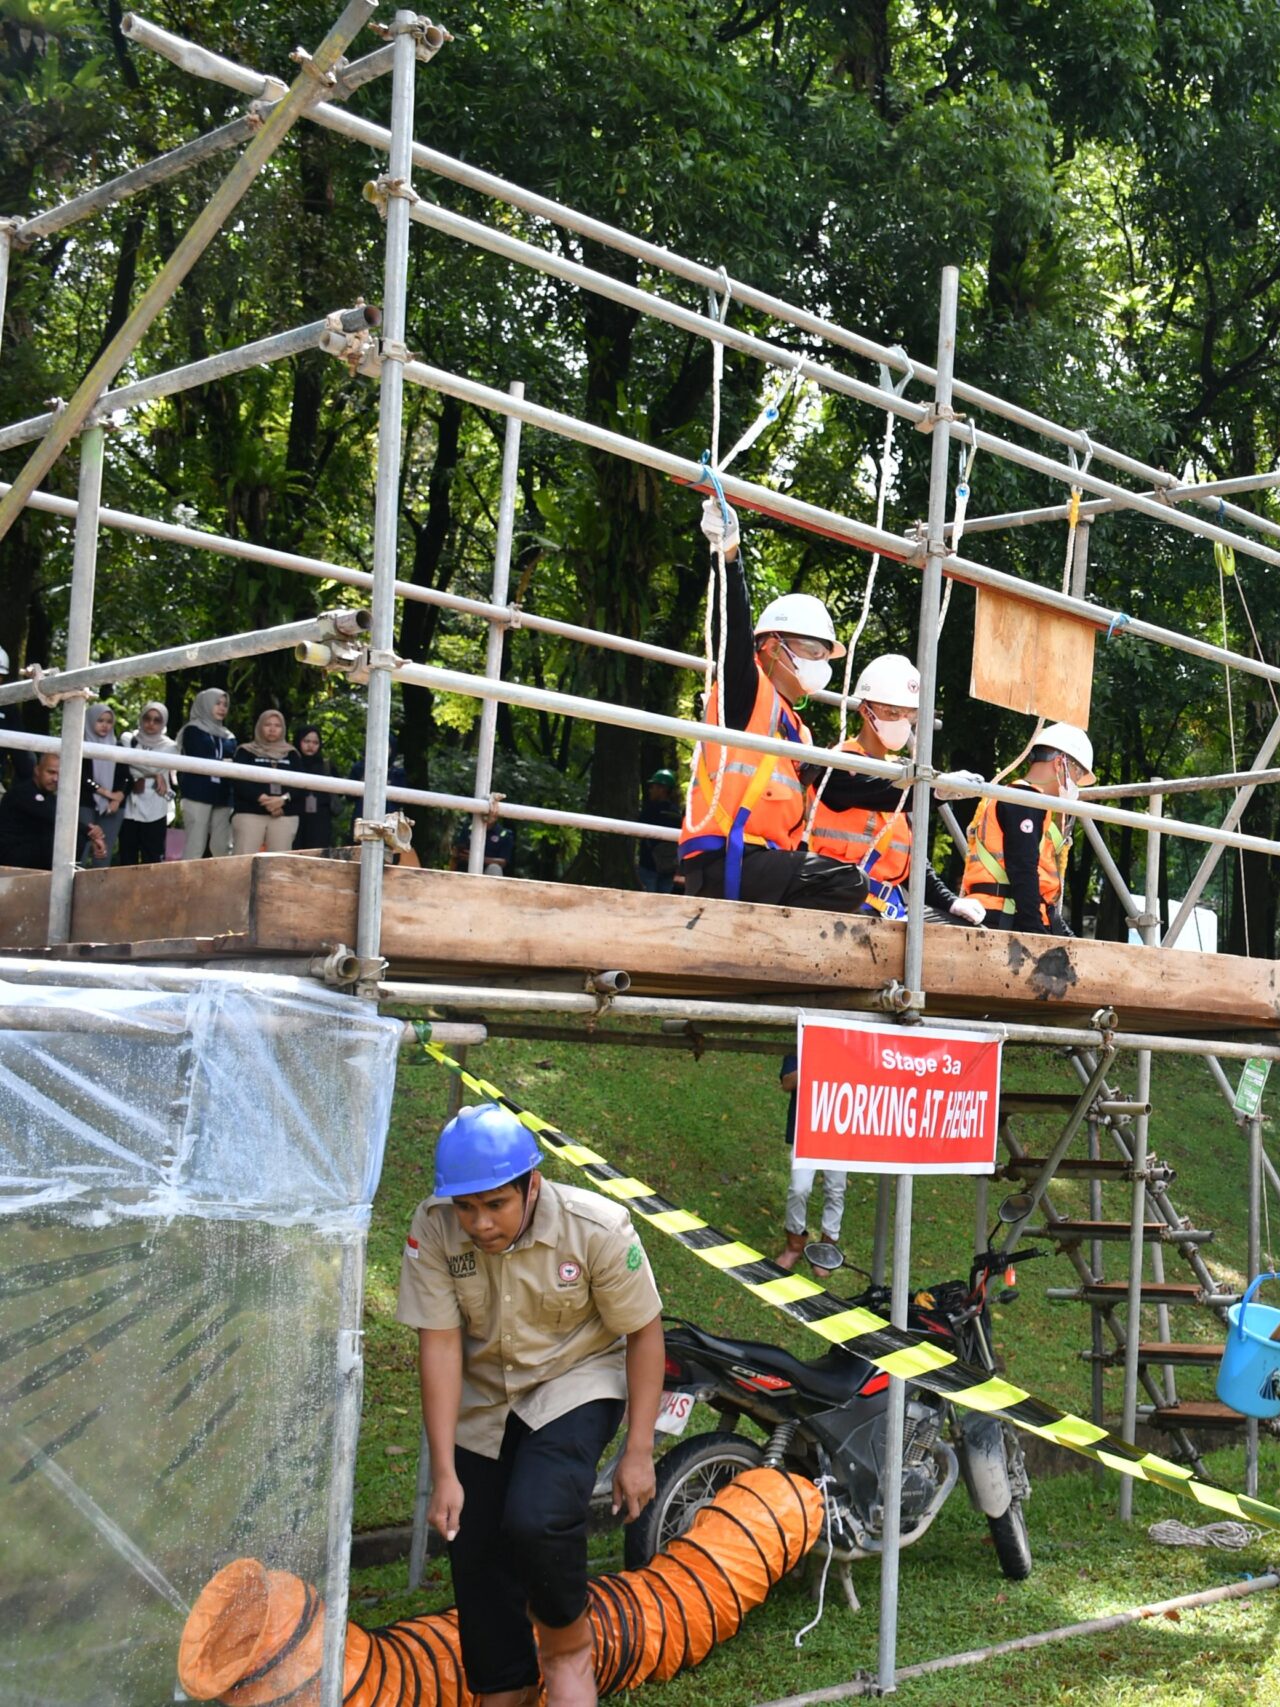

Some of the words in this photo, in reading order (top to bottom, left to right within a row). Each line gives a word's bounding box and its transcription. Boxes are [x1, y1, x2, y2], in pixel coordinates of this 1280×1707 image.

[881, 1049, 938, 1077] Stage
[942, 1055, 962, 1075] 3a
[810, 1080, 918, 1138] WORKING
[918, 1089, 944, 1138] AT
[940, 1090, 988, 1139] HEIGHT
